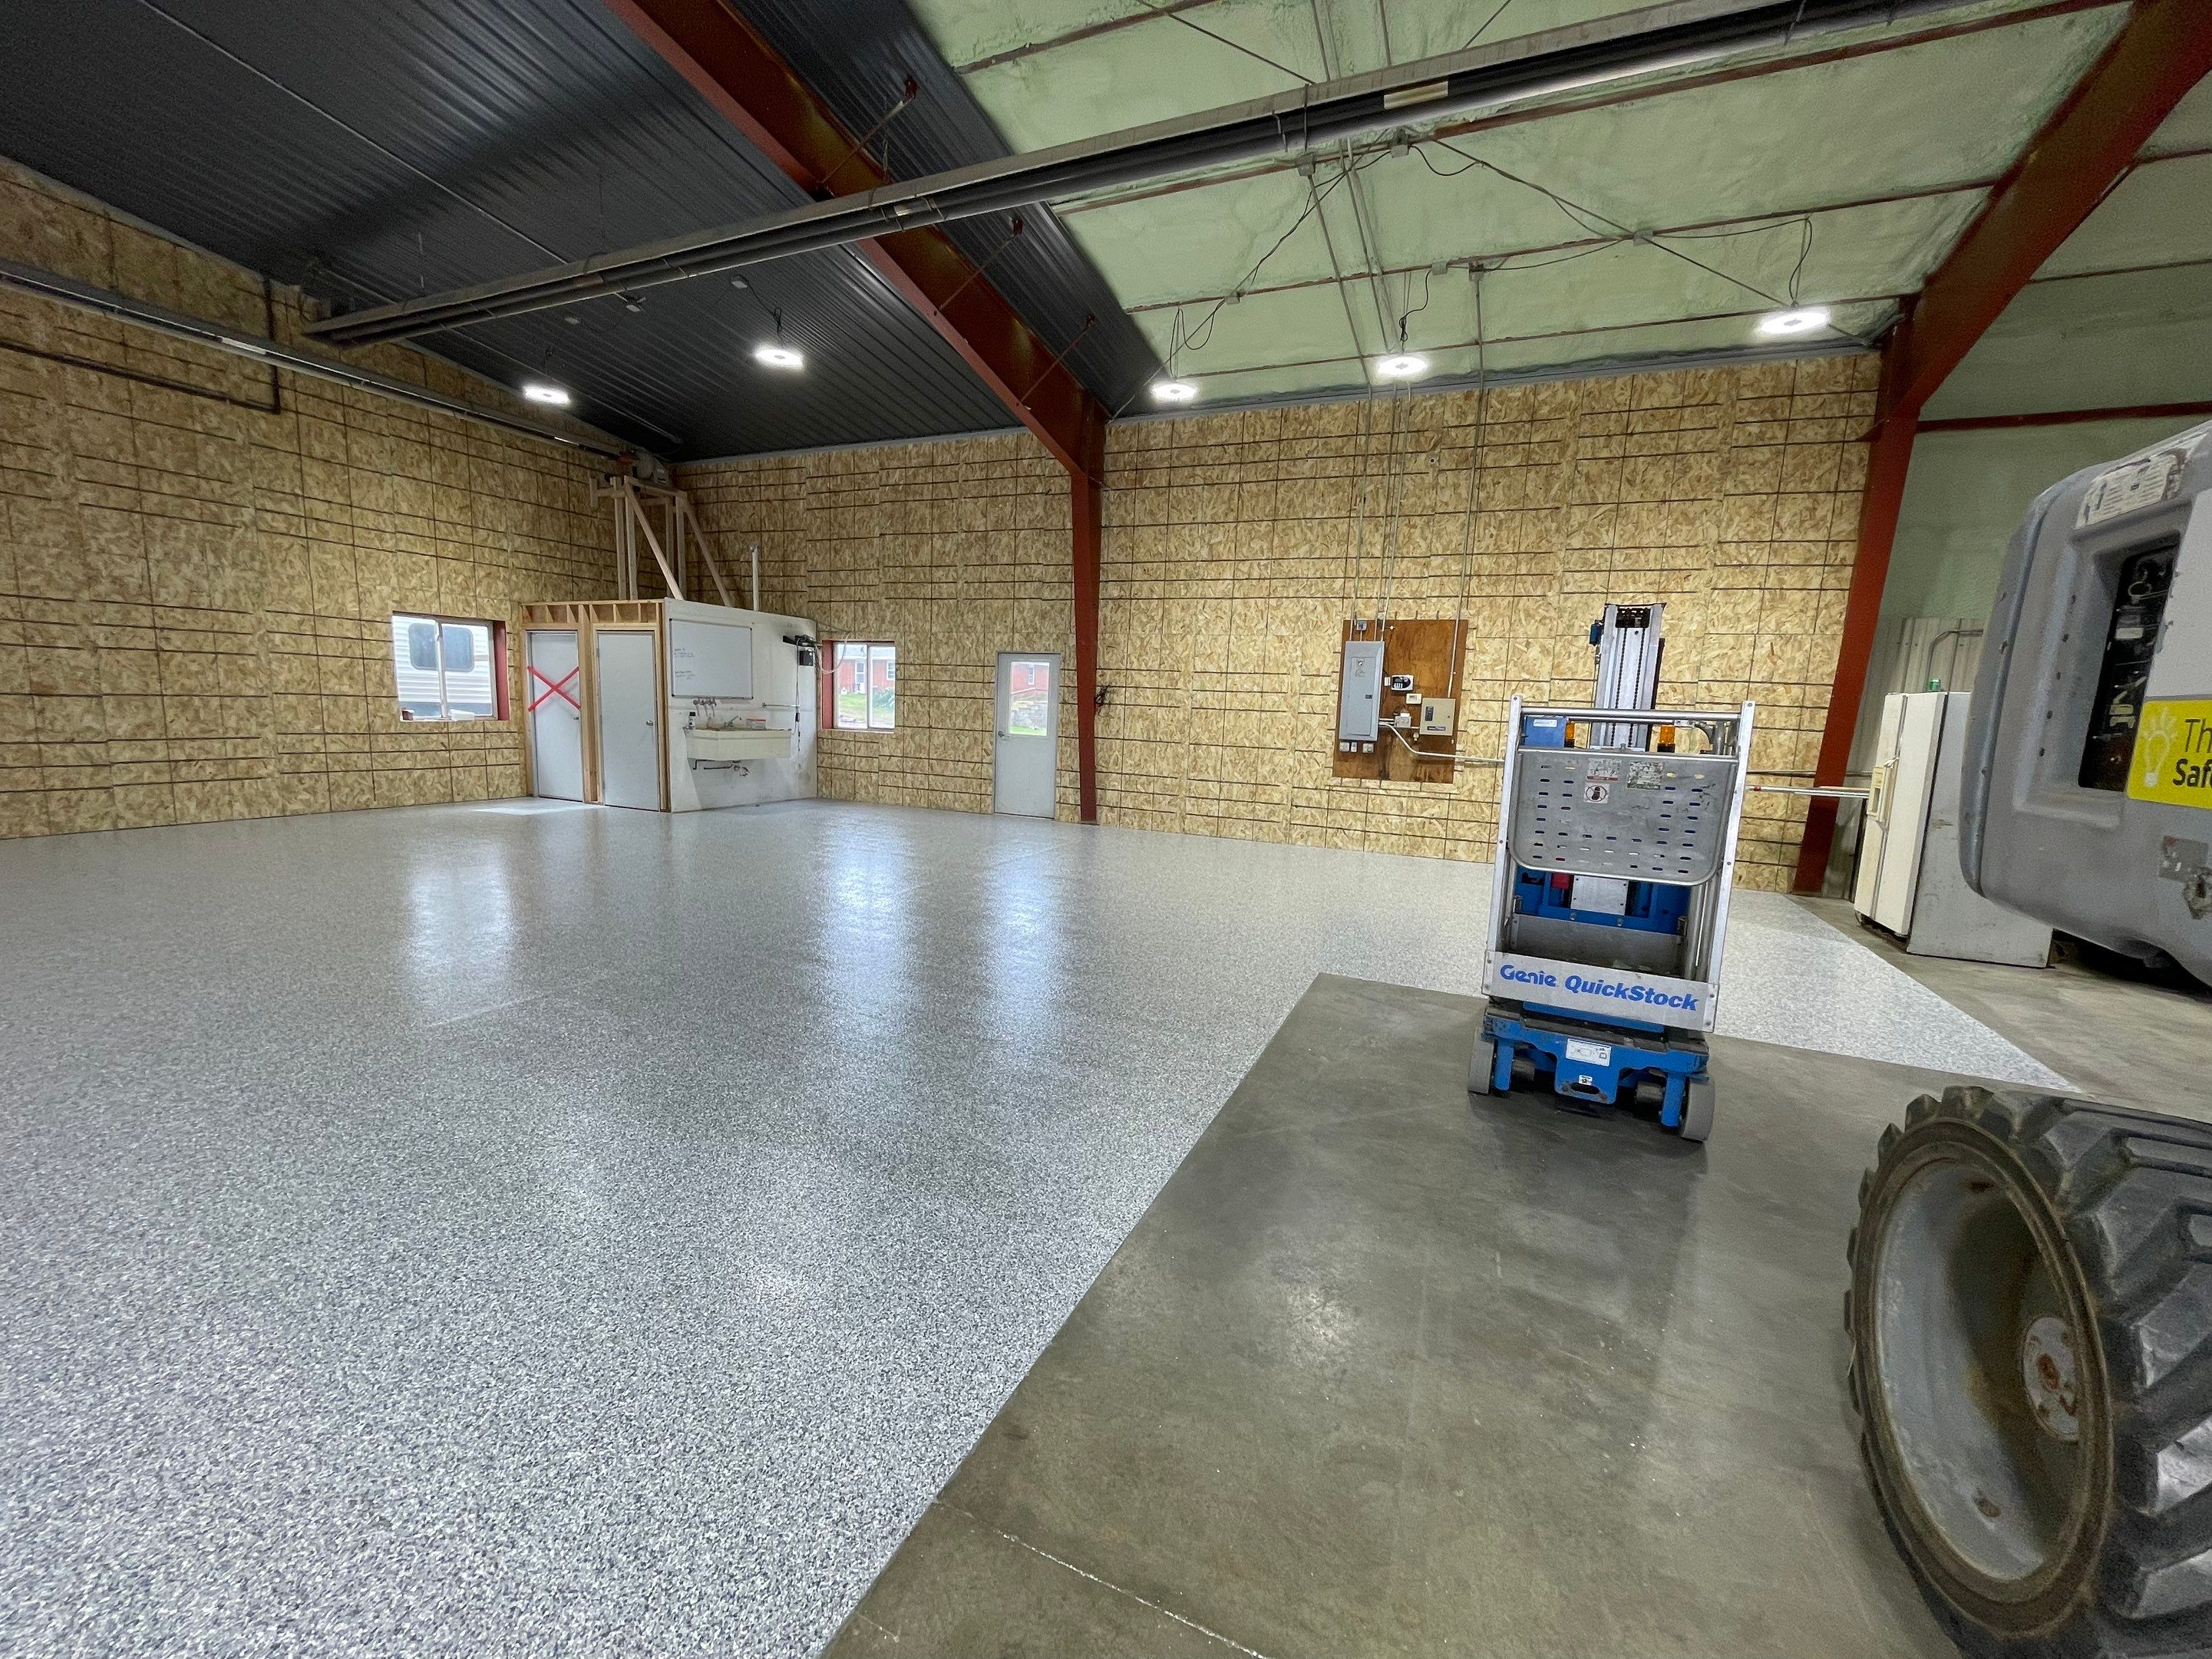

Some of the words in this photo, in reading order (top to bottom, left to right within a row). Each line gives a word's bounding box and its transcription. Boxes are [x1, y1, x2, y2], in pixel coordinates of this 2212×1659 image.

[2173, 758, 2212, 788] Saf
[1500, 965, 1557, 988] Genie
[1564, 975, 1700, 1011] QuickStock
